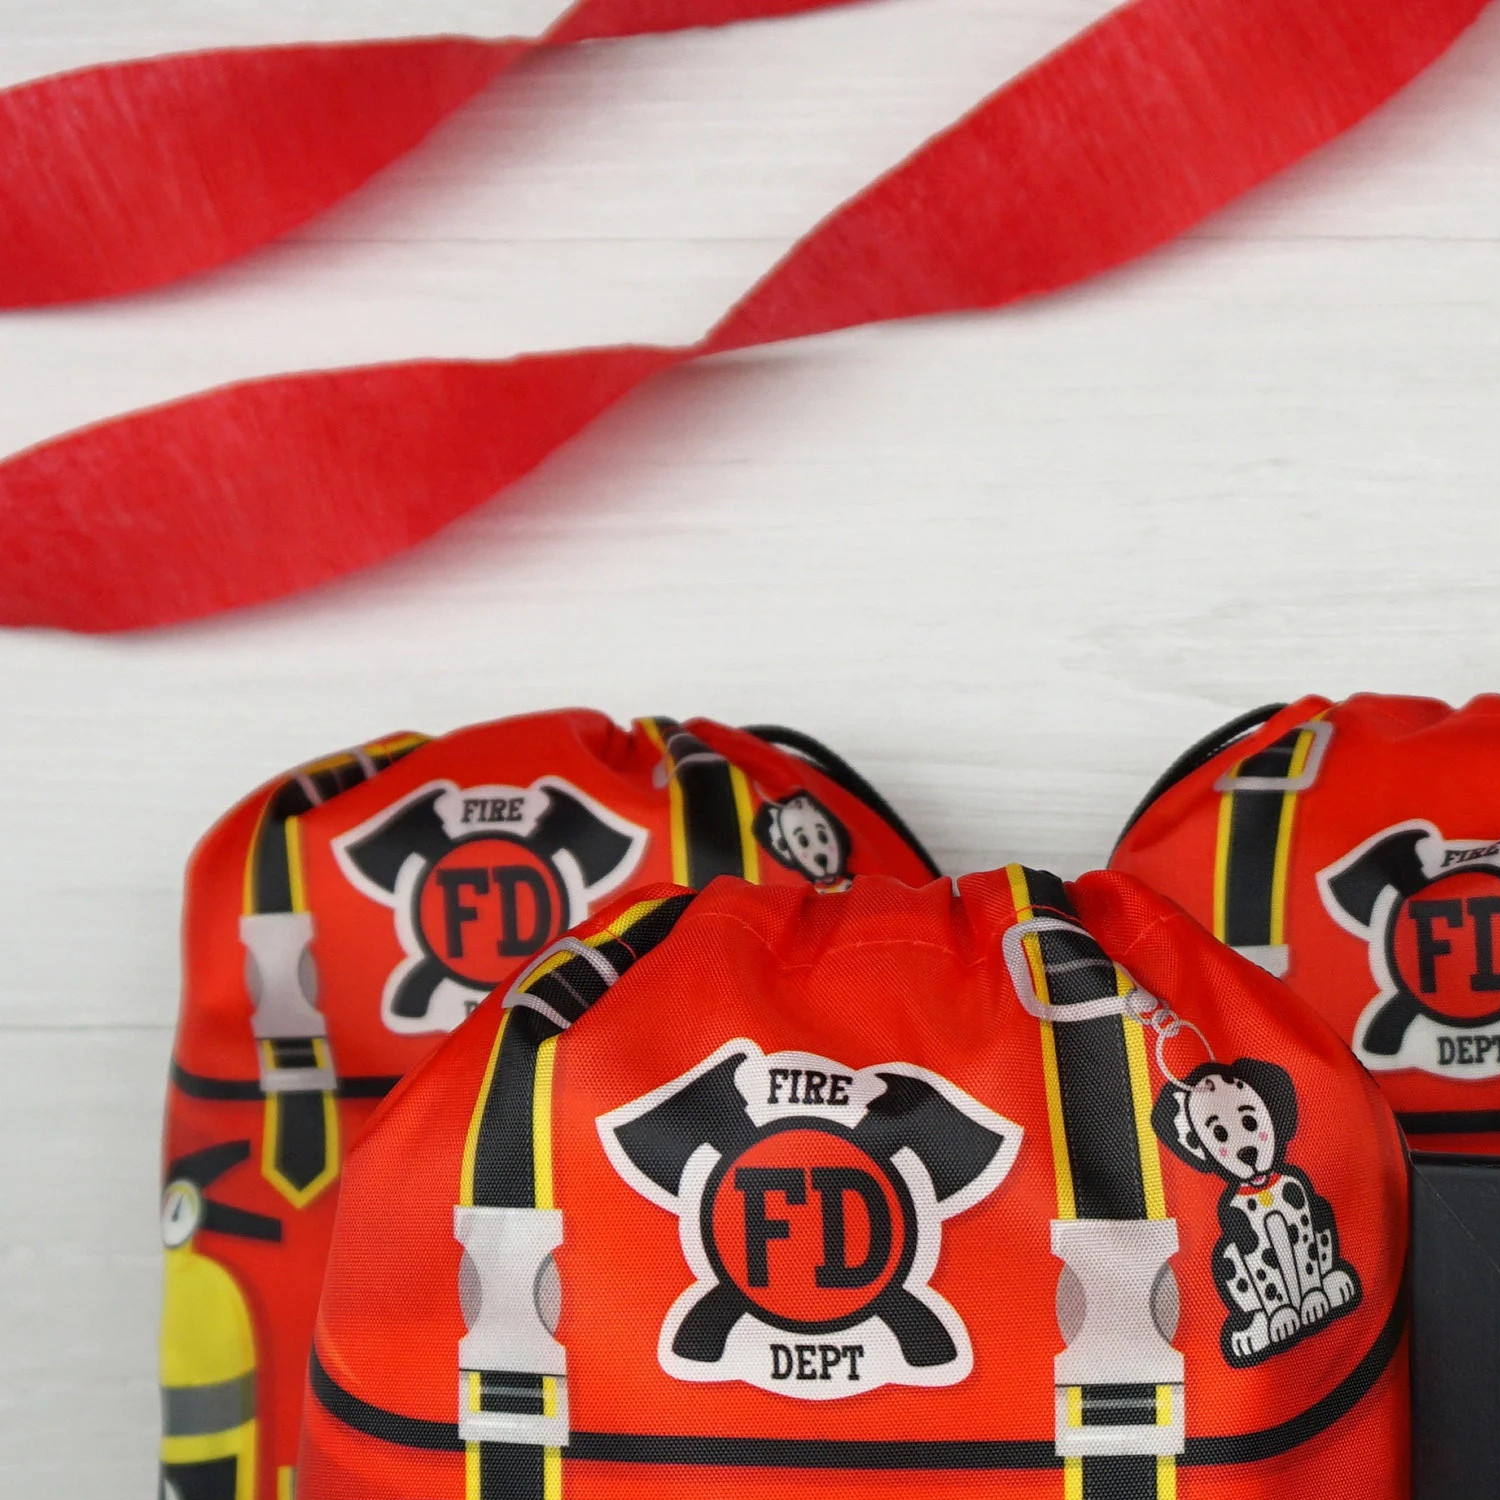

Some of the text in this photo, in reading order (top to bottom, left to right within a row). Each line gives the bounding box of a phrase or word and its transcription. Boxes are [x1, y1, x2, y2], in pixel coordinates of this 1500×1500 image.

[461, 798, 524, 824] FIRE
[436, 865, 551, 958] FD
[768, 1069, 853, 1105] FIRE
[734, 1167, 894, 1289] FD
[769, 1344, 864, 1380] DEPT
